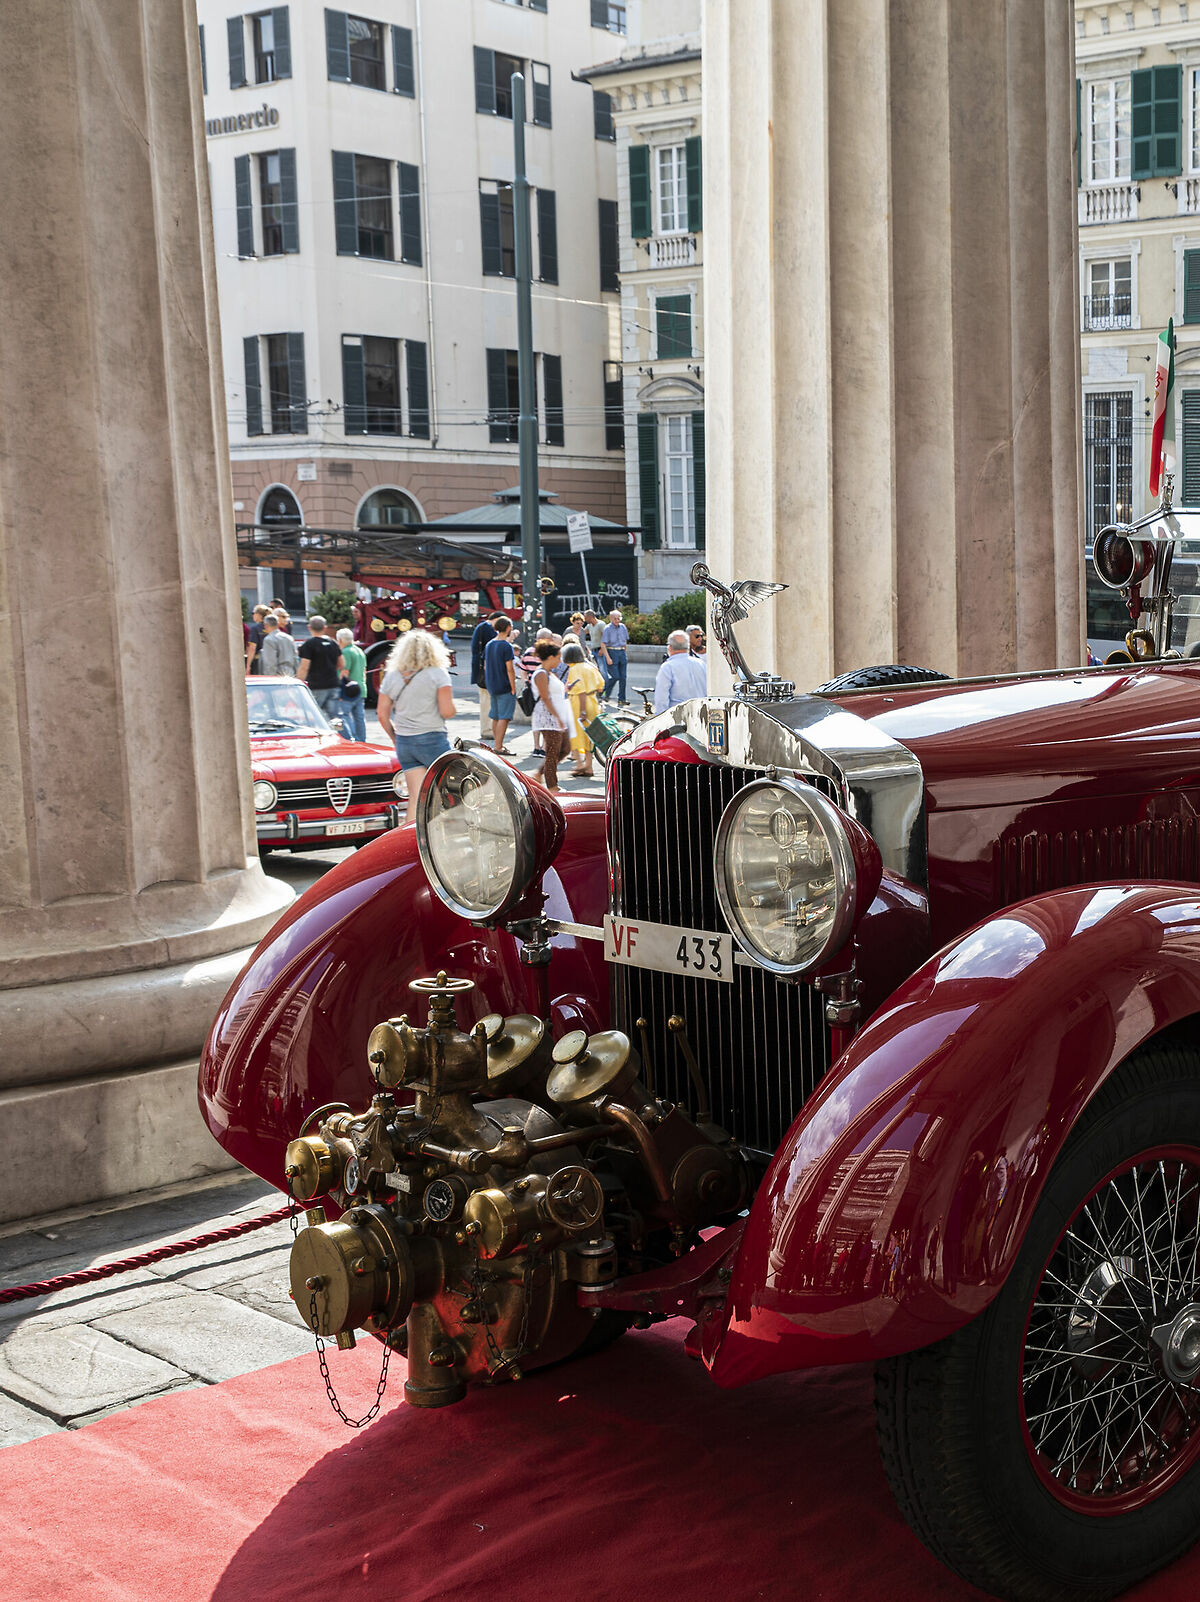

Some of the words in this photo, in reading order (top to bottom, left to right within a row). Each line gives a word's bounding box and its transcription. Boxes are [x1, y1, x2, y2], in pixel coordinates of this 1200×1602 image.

[206, 103, 279, 136] mmercio
[611, 922, 639, 958] VF
[676, 936, 721, 973] 433
